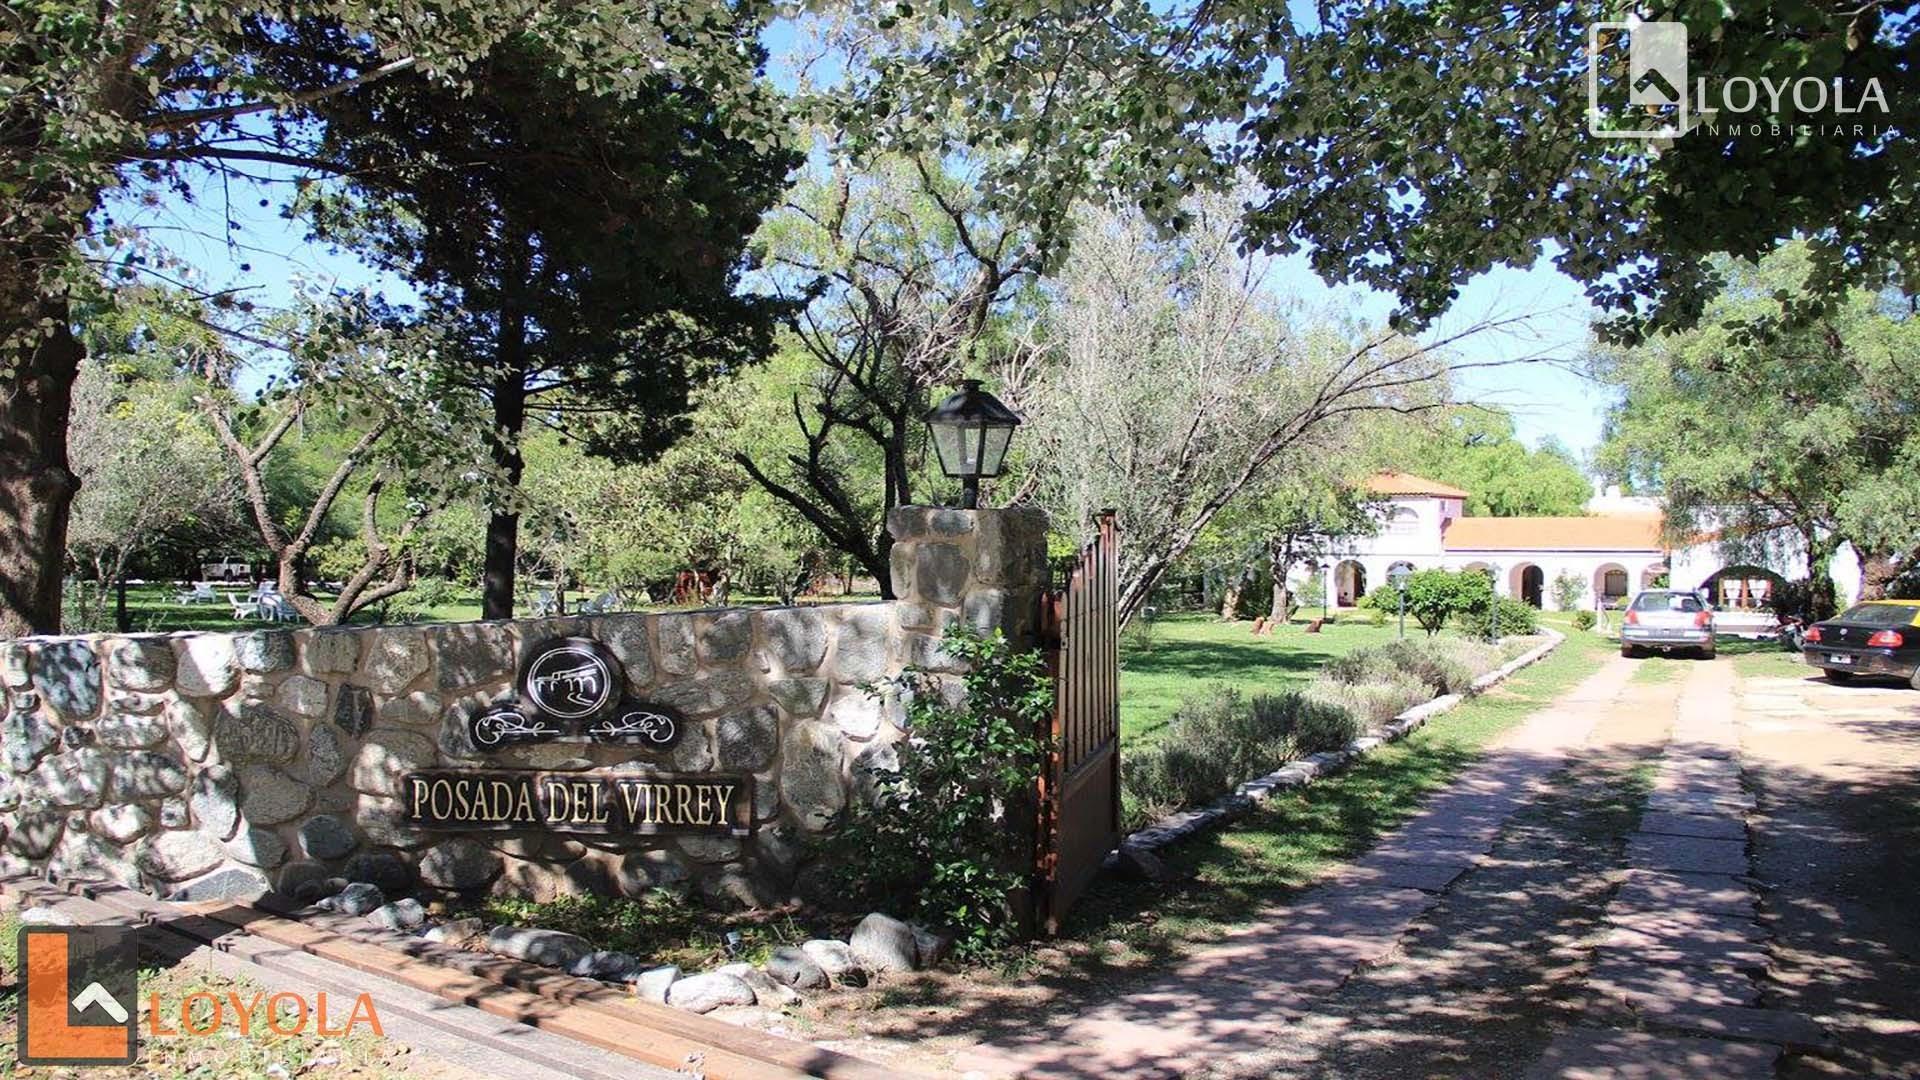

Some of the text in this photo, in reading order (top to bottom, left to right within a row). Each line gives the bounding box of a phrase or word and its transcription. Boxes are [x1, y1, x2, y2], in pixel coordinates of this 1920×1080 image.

[412, 780, 734, 825] POSADA DEL VIRREY
